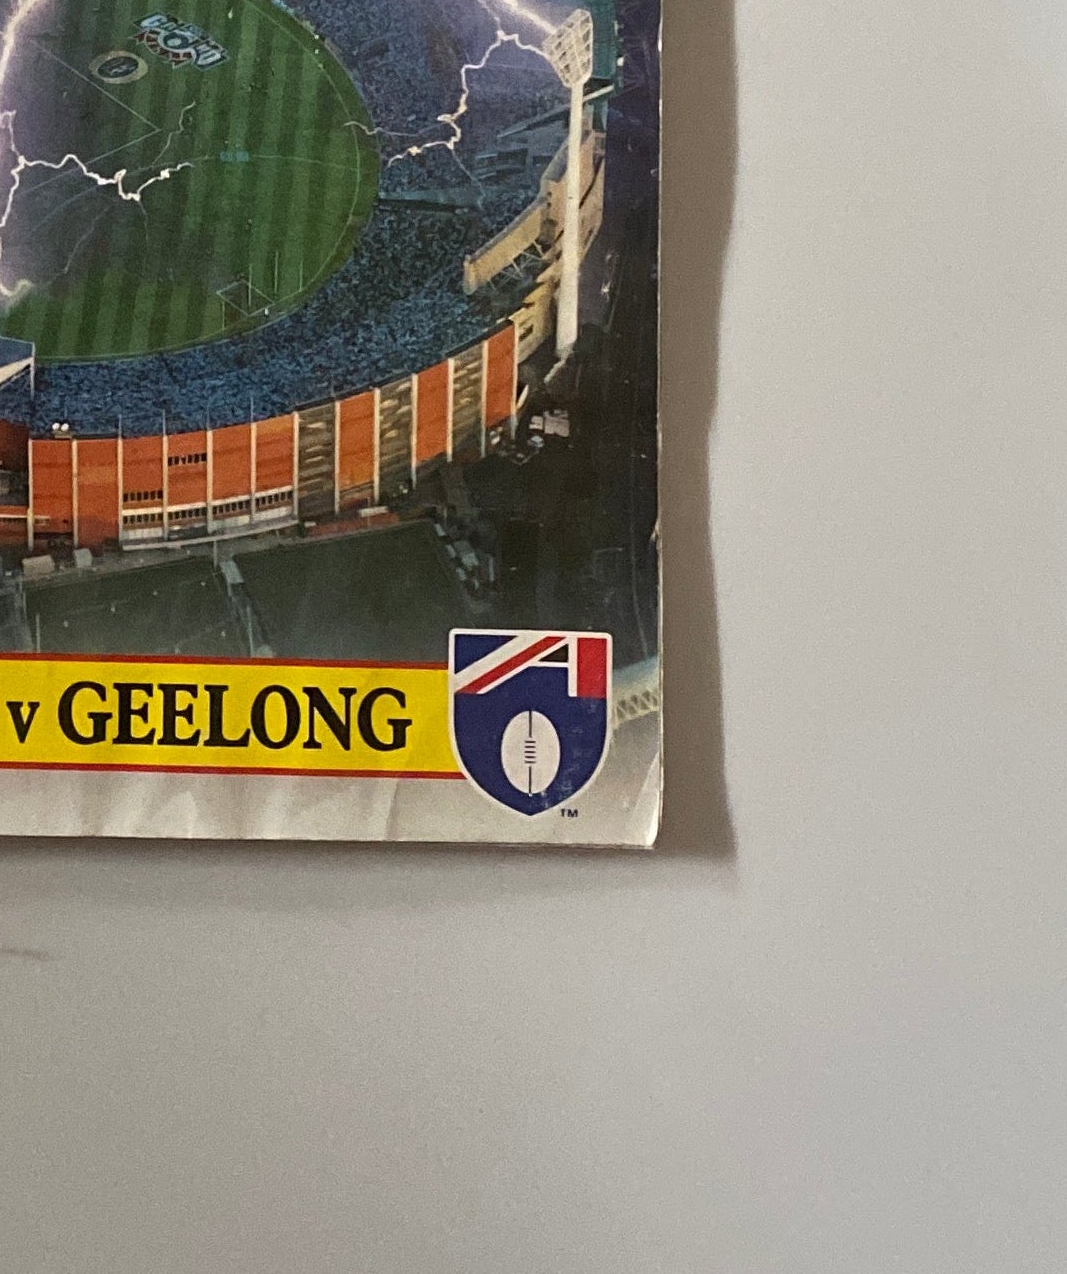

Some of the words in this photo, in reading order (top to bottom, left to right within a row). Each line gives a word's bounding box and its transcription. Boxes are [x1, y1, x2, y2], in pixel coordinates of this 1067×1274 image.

[5, 700, 40, 744] v
[57, 680, 413, 752] GEELONG
[560, 808, 579, 818] TM
